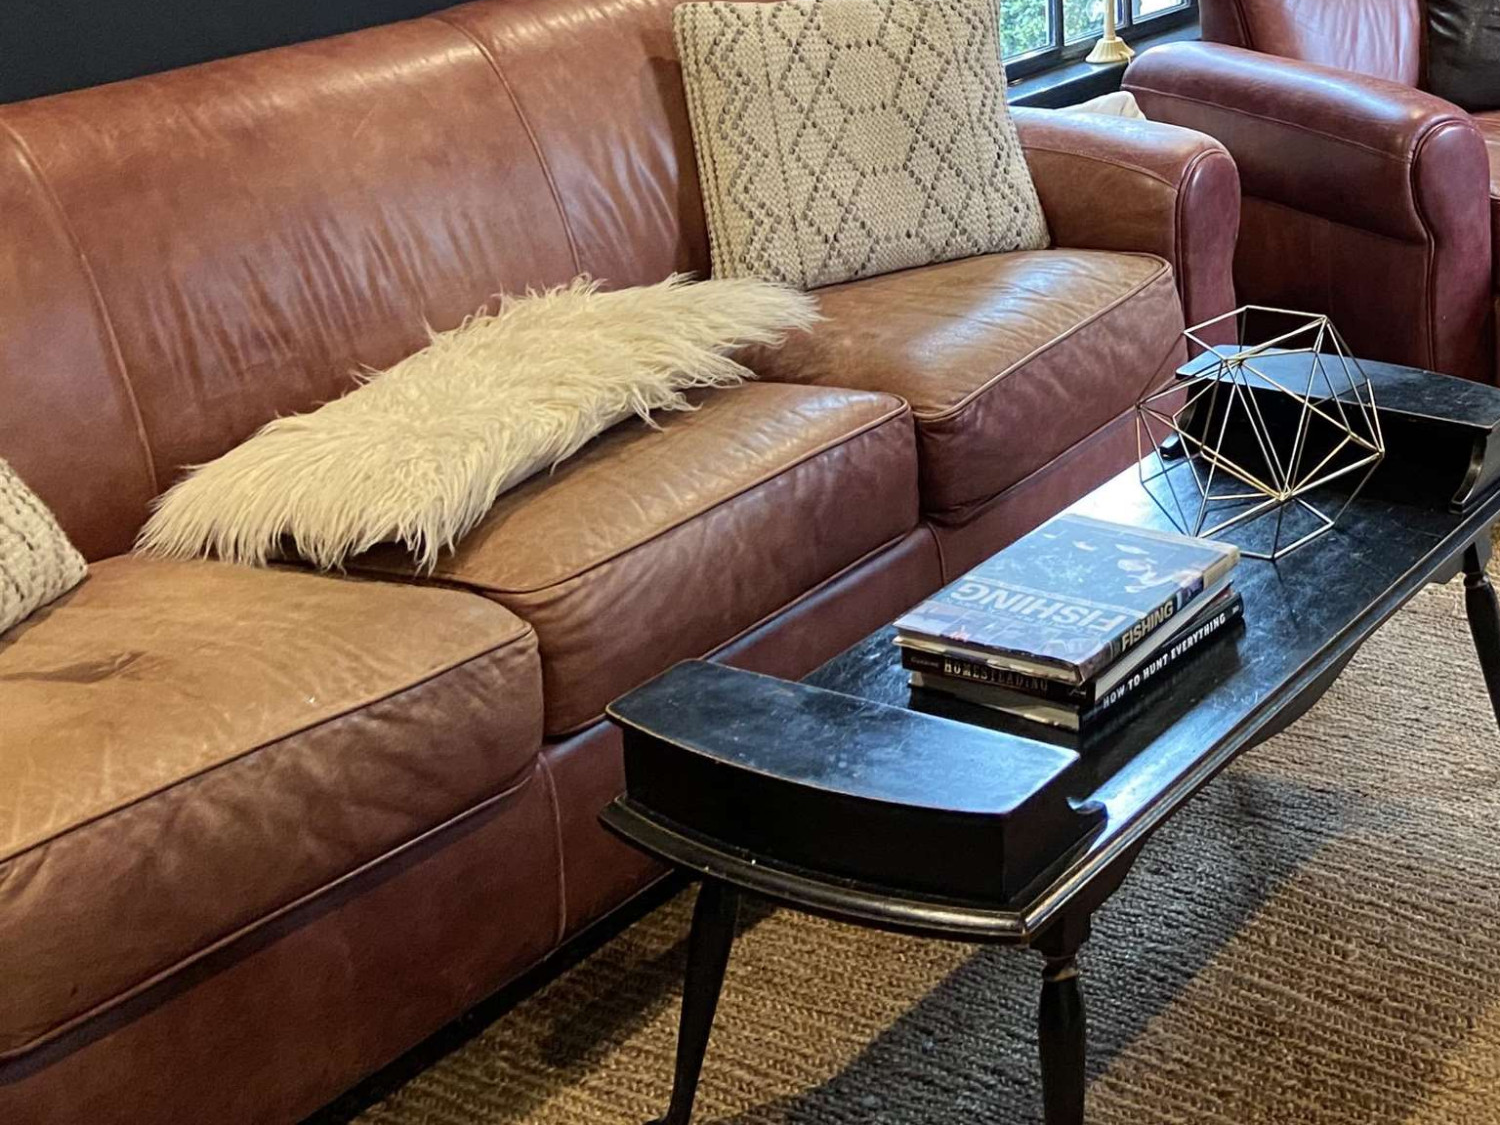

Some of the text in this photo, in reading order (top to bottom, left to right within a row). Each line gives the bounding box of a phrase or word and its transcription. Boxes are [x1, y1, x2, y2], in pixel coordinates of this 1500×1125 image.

[951, 582, 1126, 632] FISHING
[1121, 600, 1174, 652] FISHING
[1103, 685, 1126, 709] HOW
[1128, 675, 1140, 691] TO
[1143, 653, 1169, 678] HUNT
[1171, 612, 1226, 660] EVERYTHING
